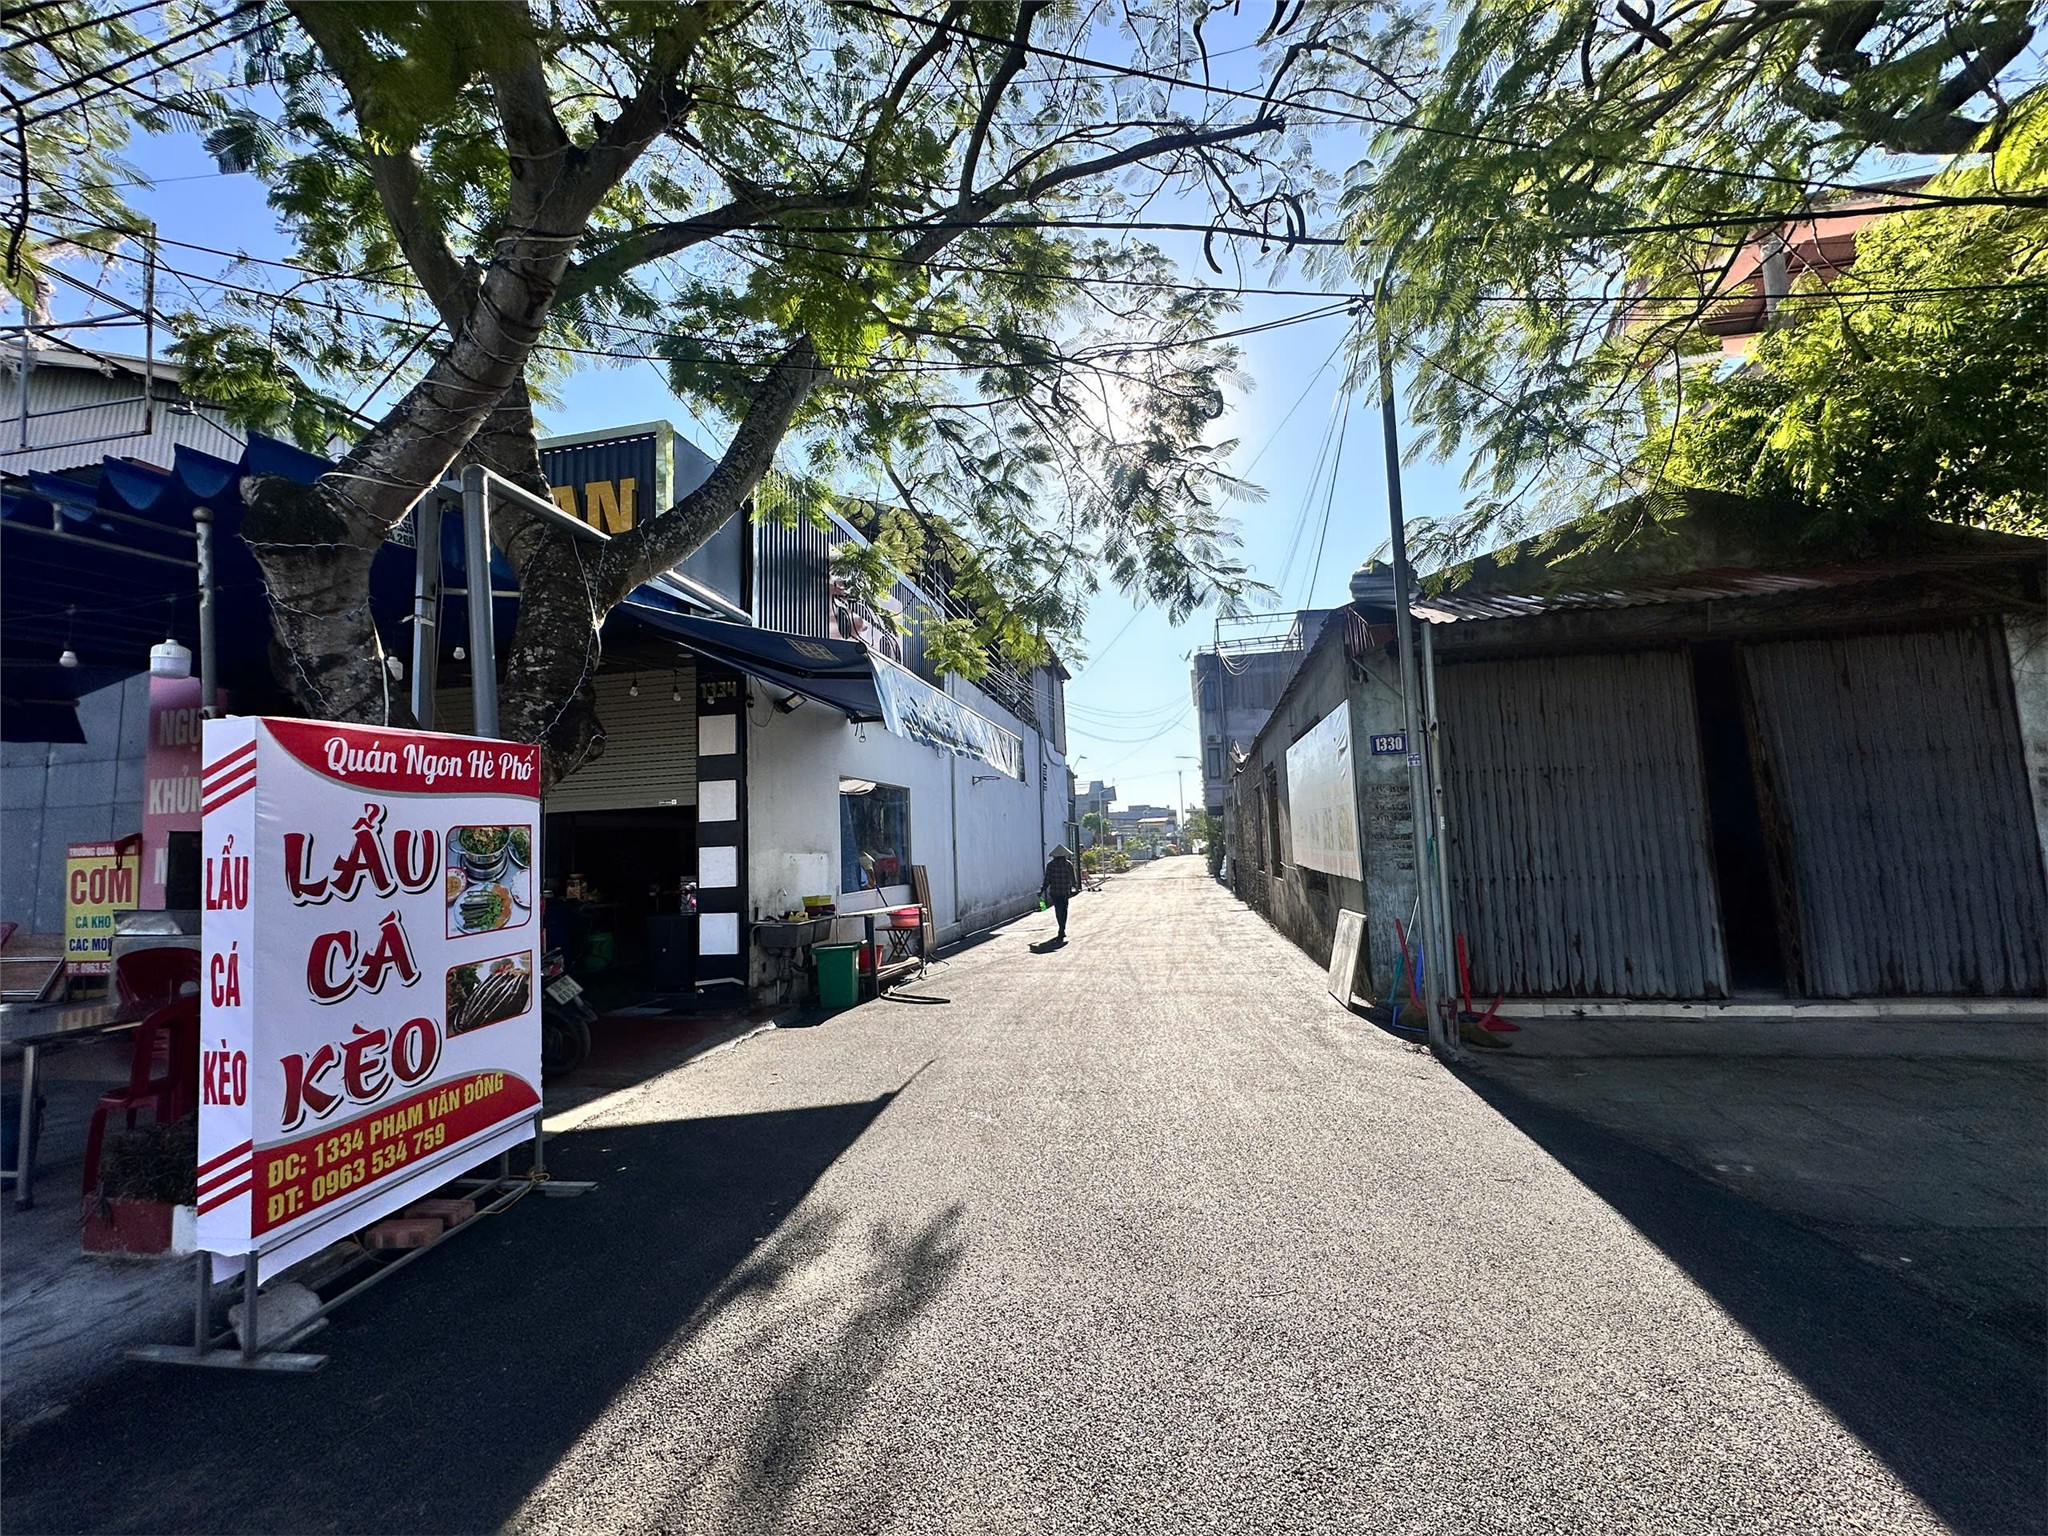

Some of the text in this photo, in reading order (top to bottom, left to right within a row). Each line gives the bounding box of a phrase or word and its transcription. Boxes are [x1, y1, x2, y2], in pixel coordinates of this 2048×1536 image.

[324, 737, 535, 785] Quán Ngon Hè Phố
[1375, 736, 1403, 752] 1330
[70, 865, 132, 905] CƠM
[206, 833, 249, 910] LẨU
[284, 803, 440, 904] LẨU
[91, 915, 111, 929] KHO
[307, 910, 420, 1004] CÁ
[210, 940, 241, 1008] CÁ
[203, 1038, 247, 1107] KÈO
[280, 1017, 440, 1130] KÈO
[267, 1152, 307, 1189] ĐC:
[314, 1128, 364, 1168] 1334
[370, 1103, 424, 1146] PHẠM
[427, 1087, 460, 1120] VĂN
[267, 1122, 446, 1224] ĐT: 0963 534 759
